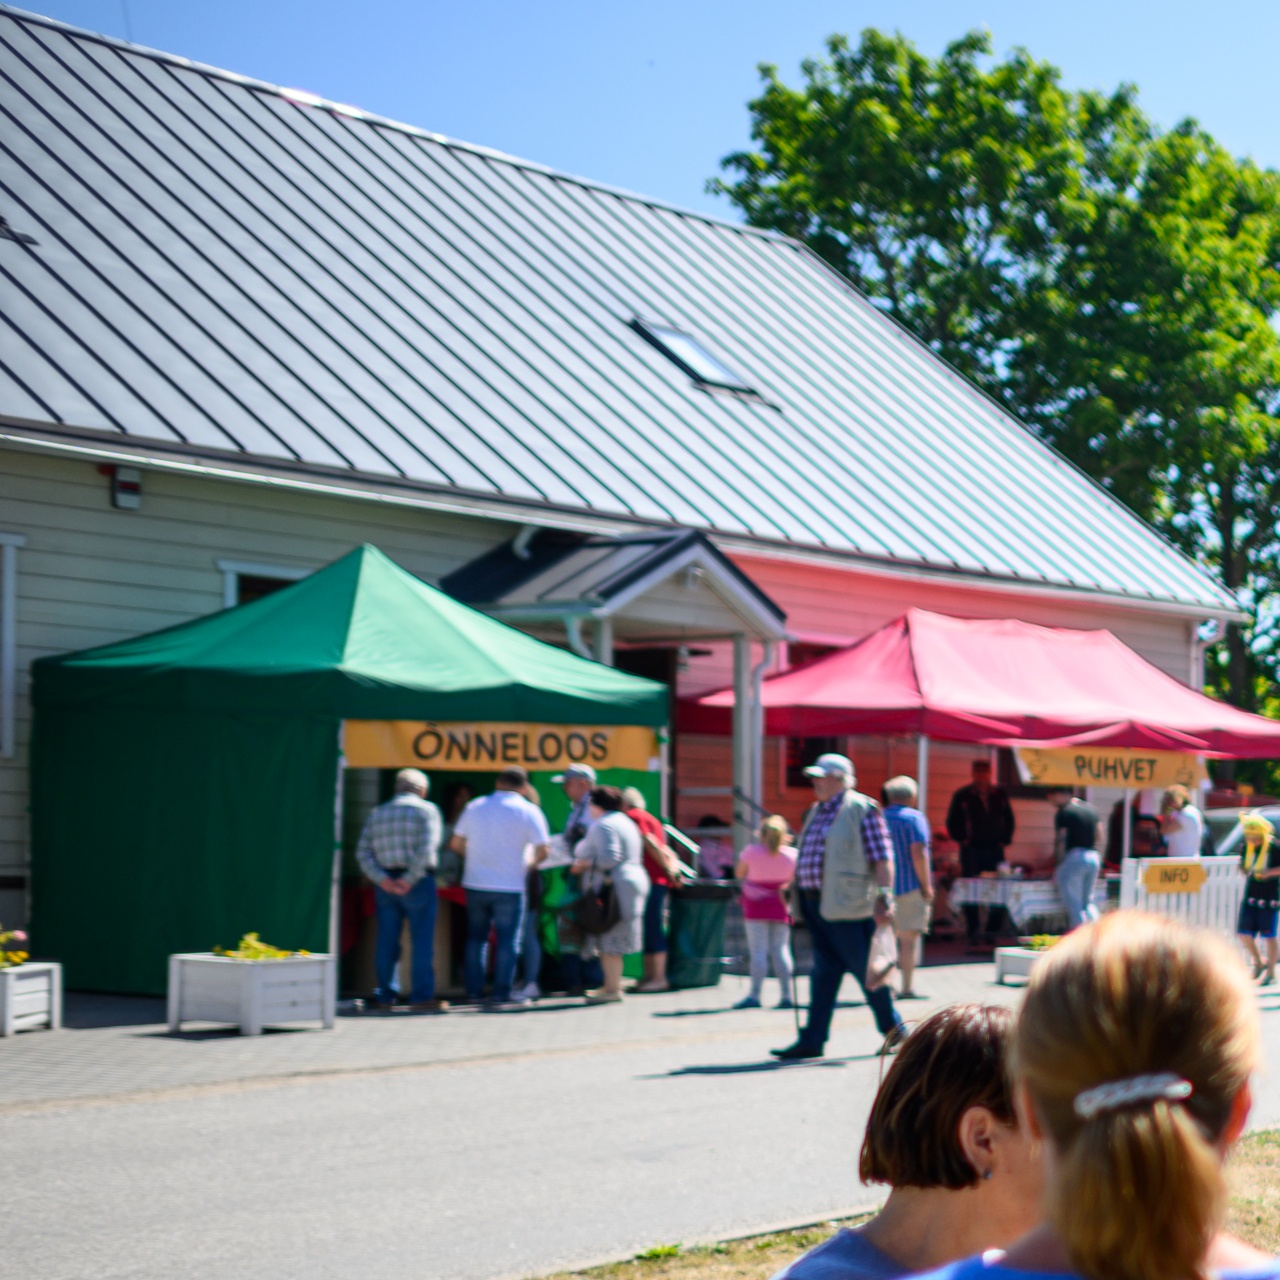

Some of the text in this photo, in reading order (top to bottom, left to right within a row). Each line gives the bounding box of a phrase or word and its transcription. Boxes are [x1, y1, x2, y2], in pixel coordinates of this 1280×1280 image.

[412, 722, 609, 763] ÕNNELOOS
[1073, 754, 1158, 782] PUHVET
[1159, 867, 1190, 883] INFO
